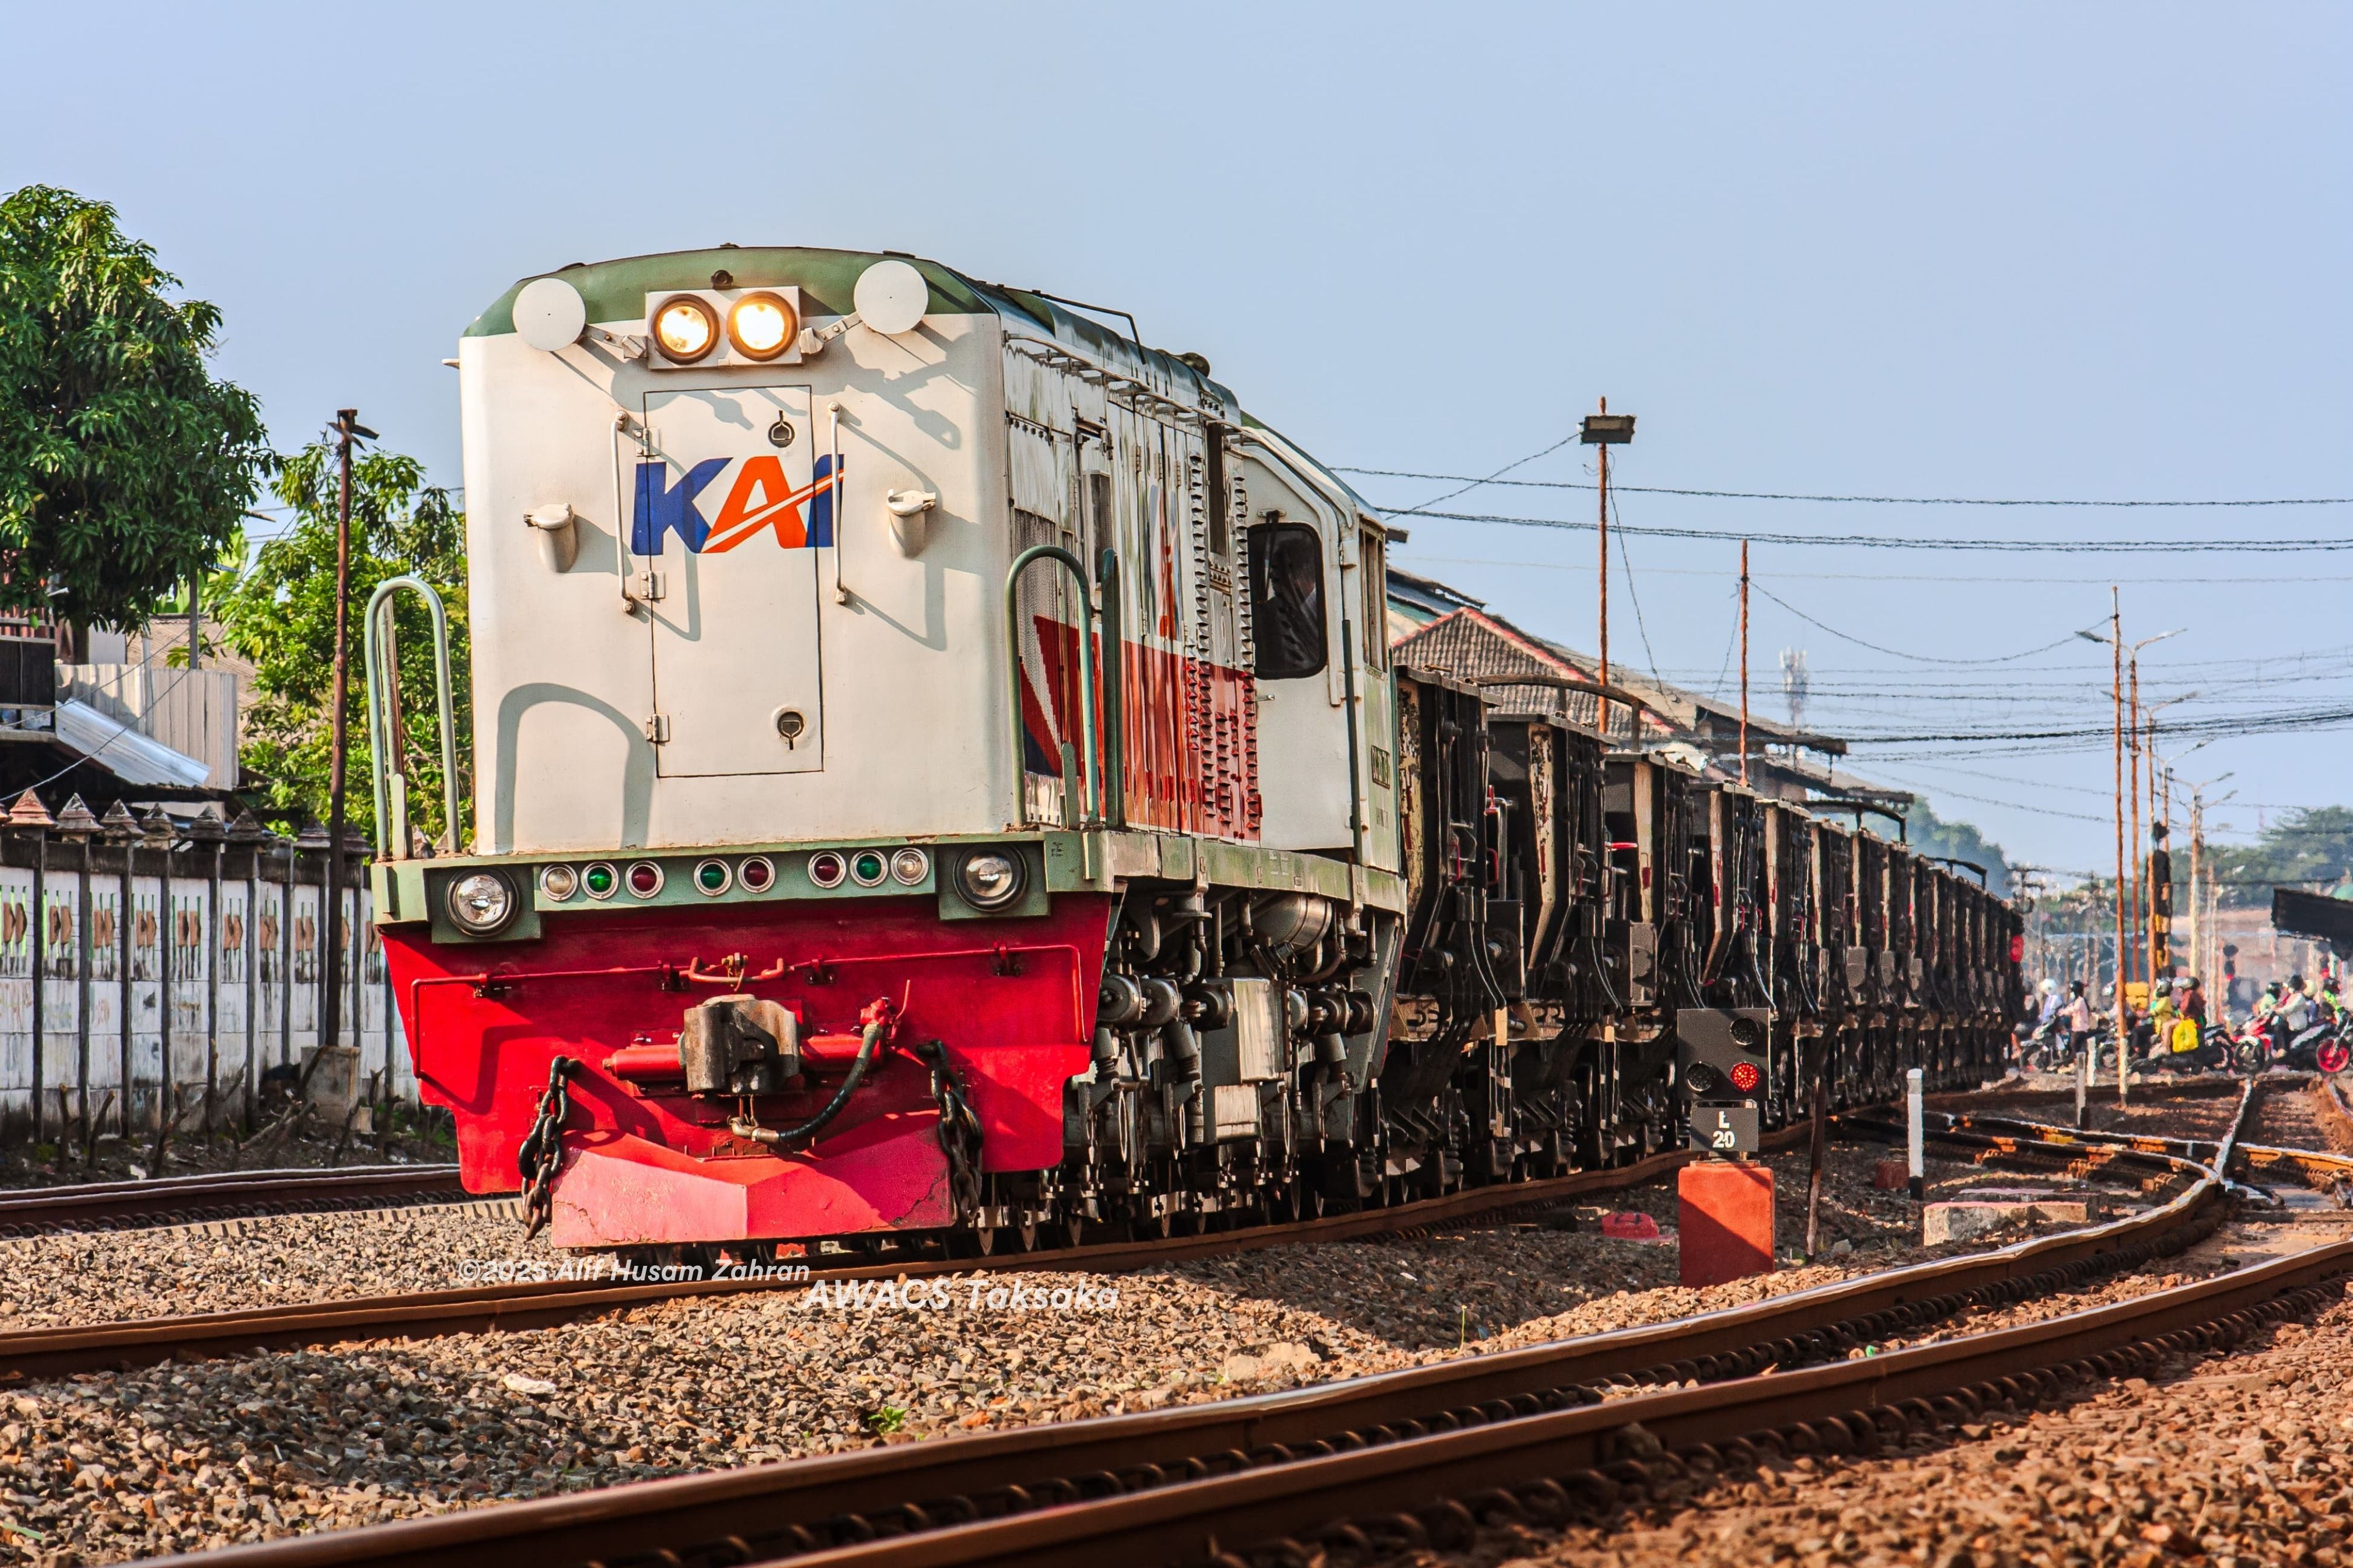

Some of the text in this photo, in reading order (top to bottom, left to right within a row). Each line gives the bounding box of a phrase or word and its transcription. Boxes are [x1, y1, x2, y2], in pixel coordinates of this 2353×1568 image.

[631, 453, 845, 556] KAI
[1718, 1110, 1730, 1129] L
[1712, 1130, 1736, 1149] 20
